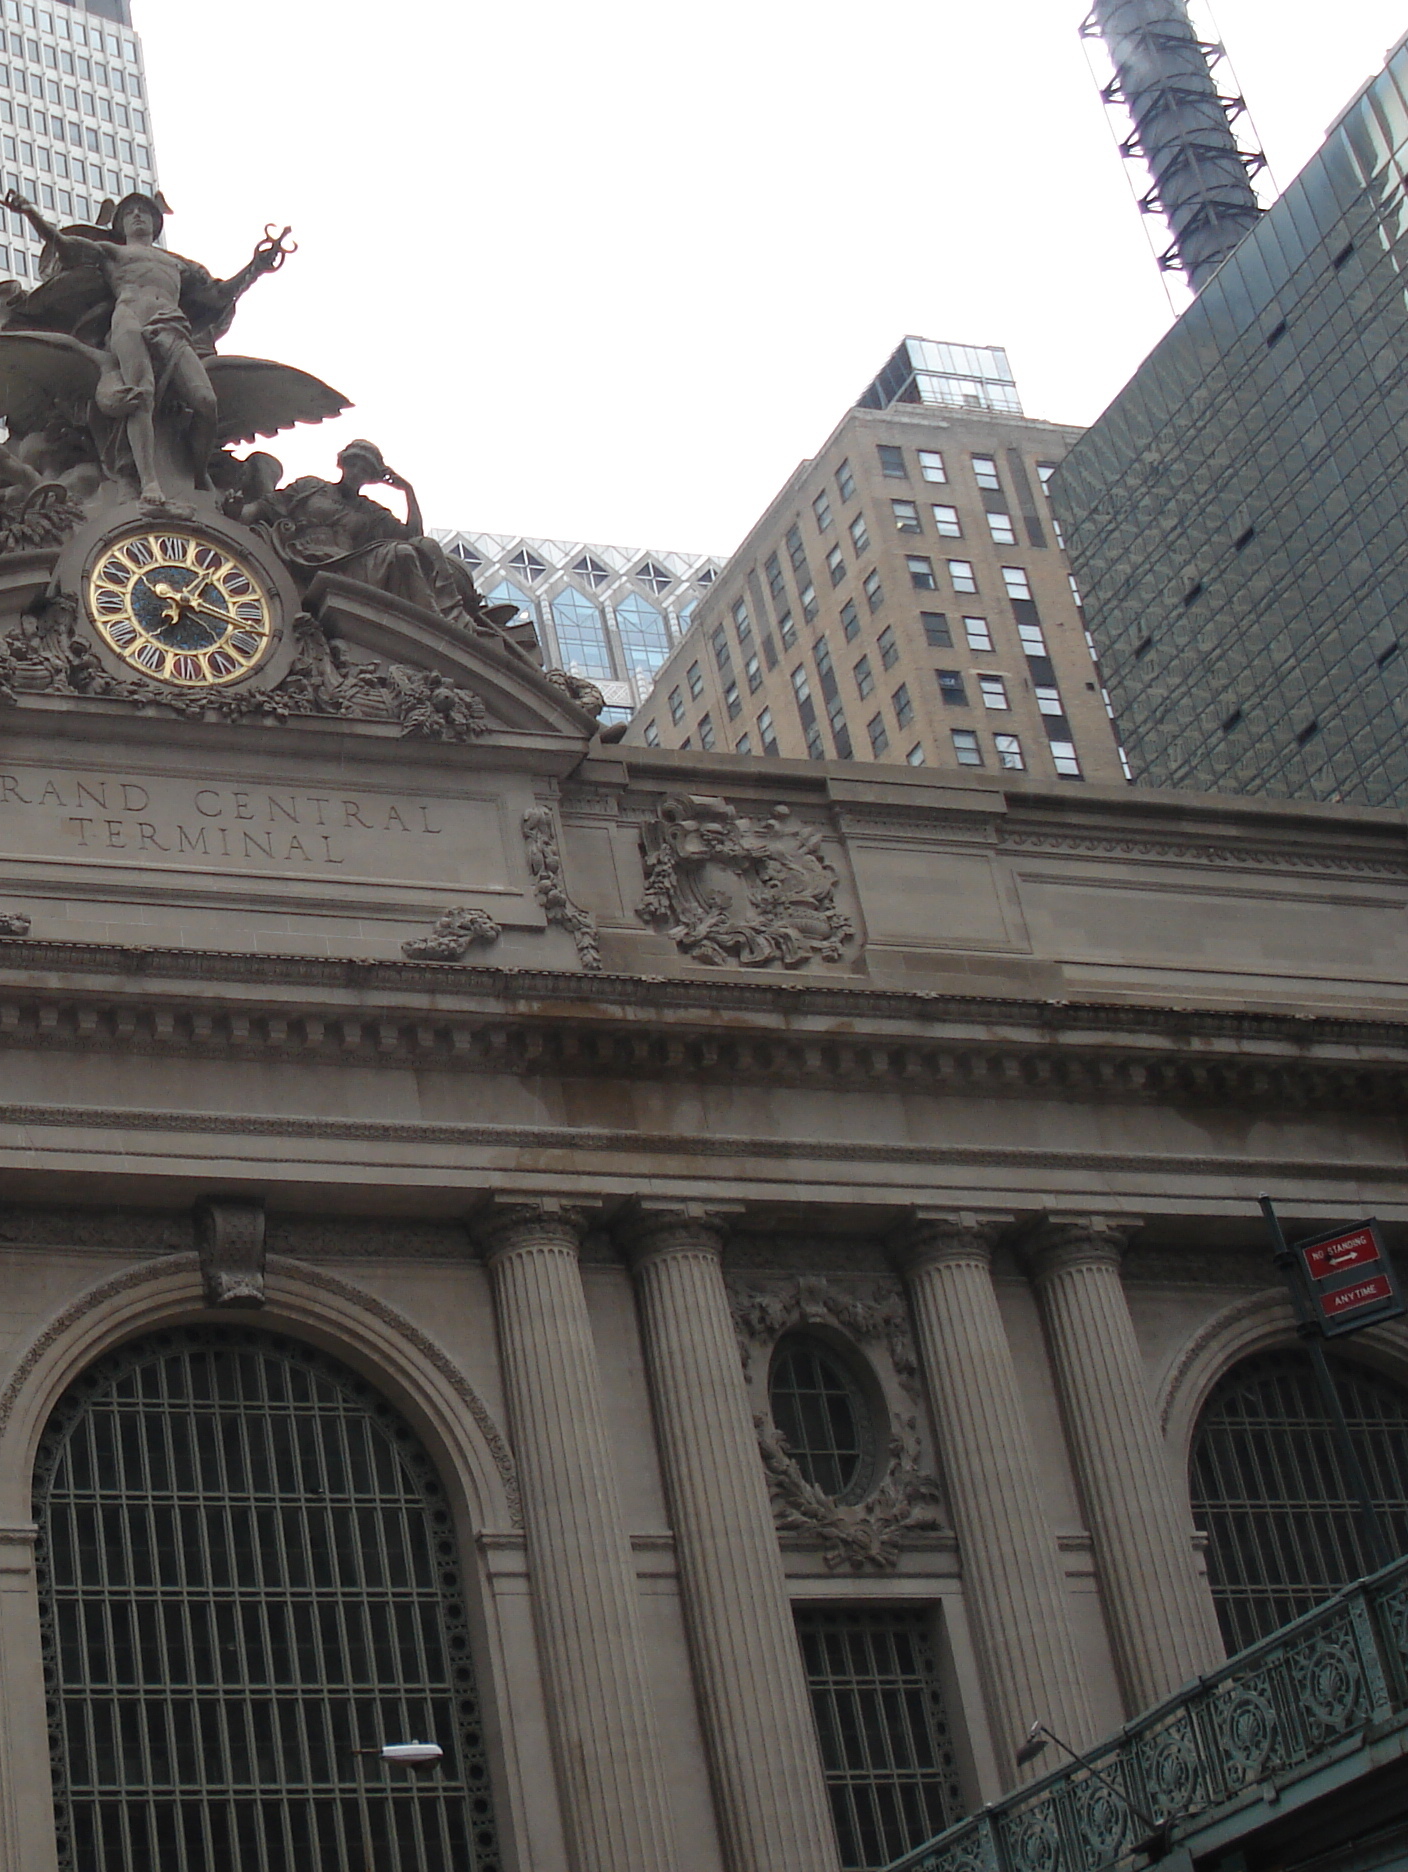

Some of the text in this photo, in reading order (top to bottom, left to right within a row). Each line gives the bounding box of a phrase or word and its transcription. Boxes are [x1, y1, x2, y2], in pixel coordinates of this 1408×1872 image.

[127, 541, 152, 566] XI
[163, 536, 184, 561] XII
[202, 550, 216, 570] I
[103, 563, 130, 583] X
[225, 576, 249, 590] II
[96, 595, 124, 608] IX
[236, 607, 262, 619] III
[108, 621, 137, 645] VIII
[139, 645, 160, 670] VII
[180, 654, 196, 680] VI
[213, 653, 235, 675] V
[194, 789, 442, 834] CENTRAL
[68, 817, 345, 864] TERMINAL
[1312, 1236, 1367, 1261] NO STANDING
[1335, 1284, 1377, 1305] ANYTIME
